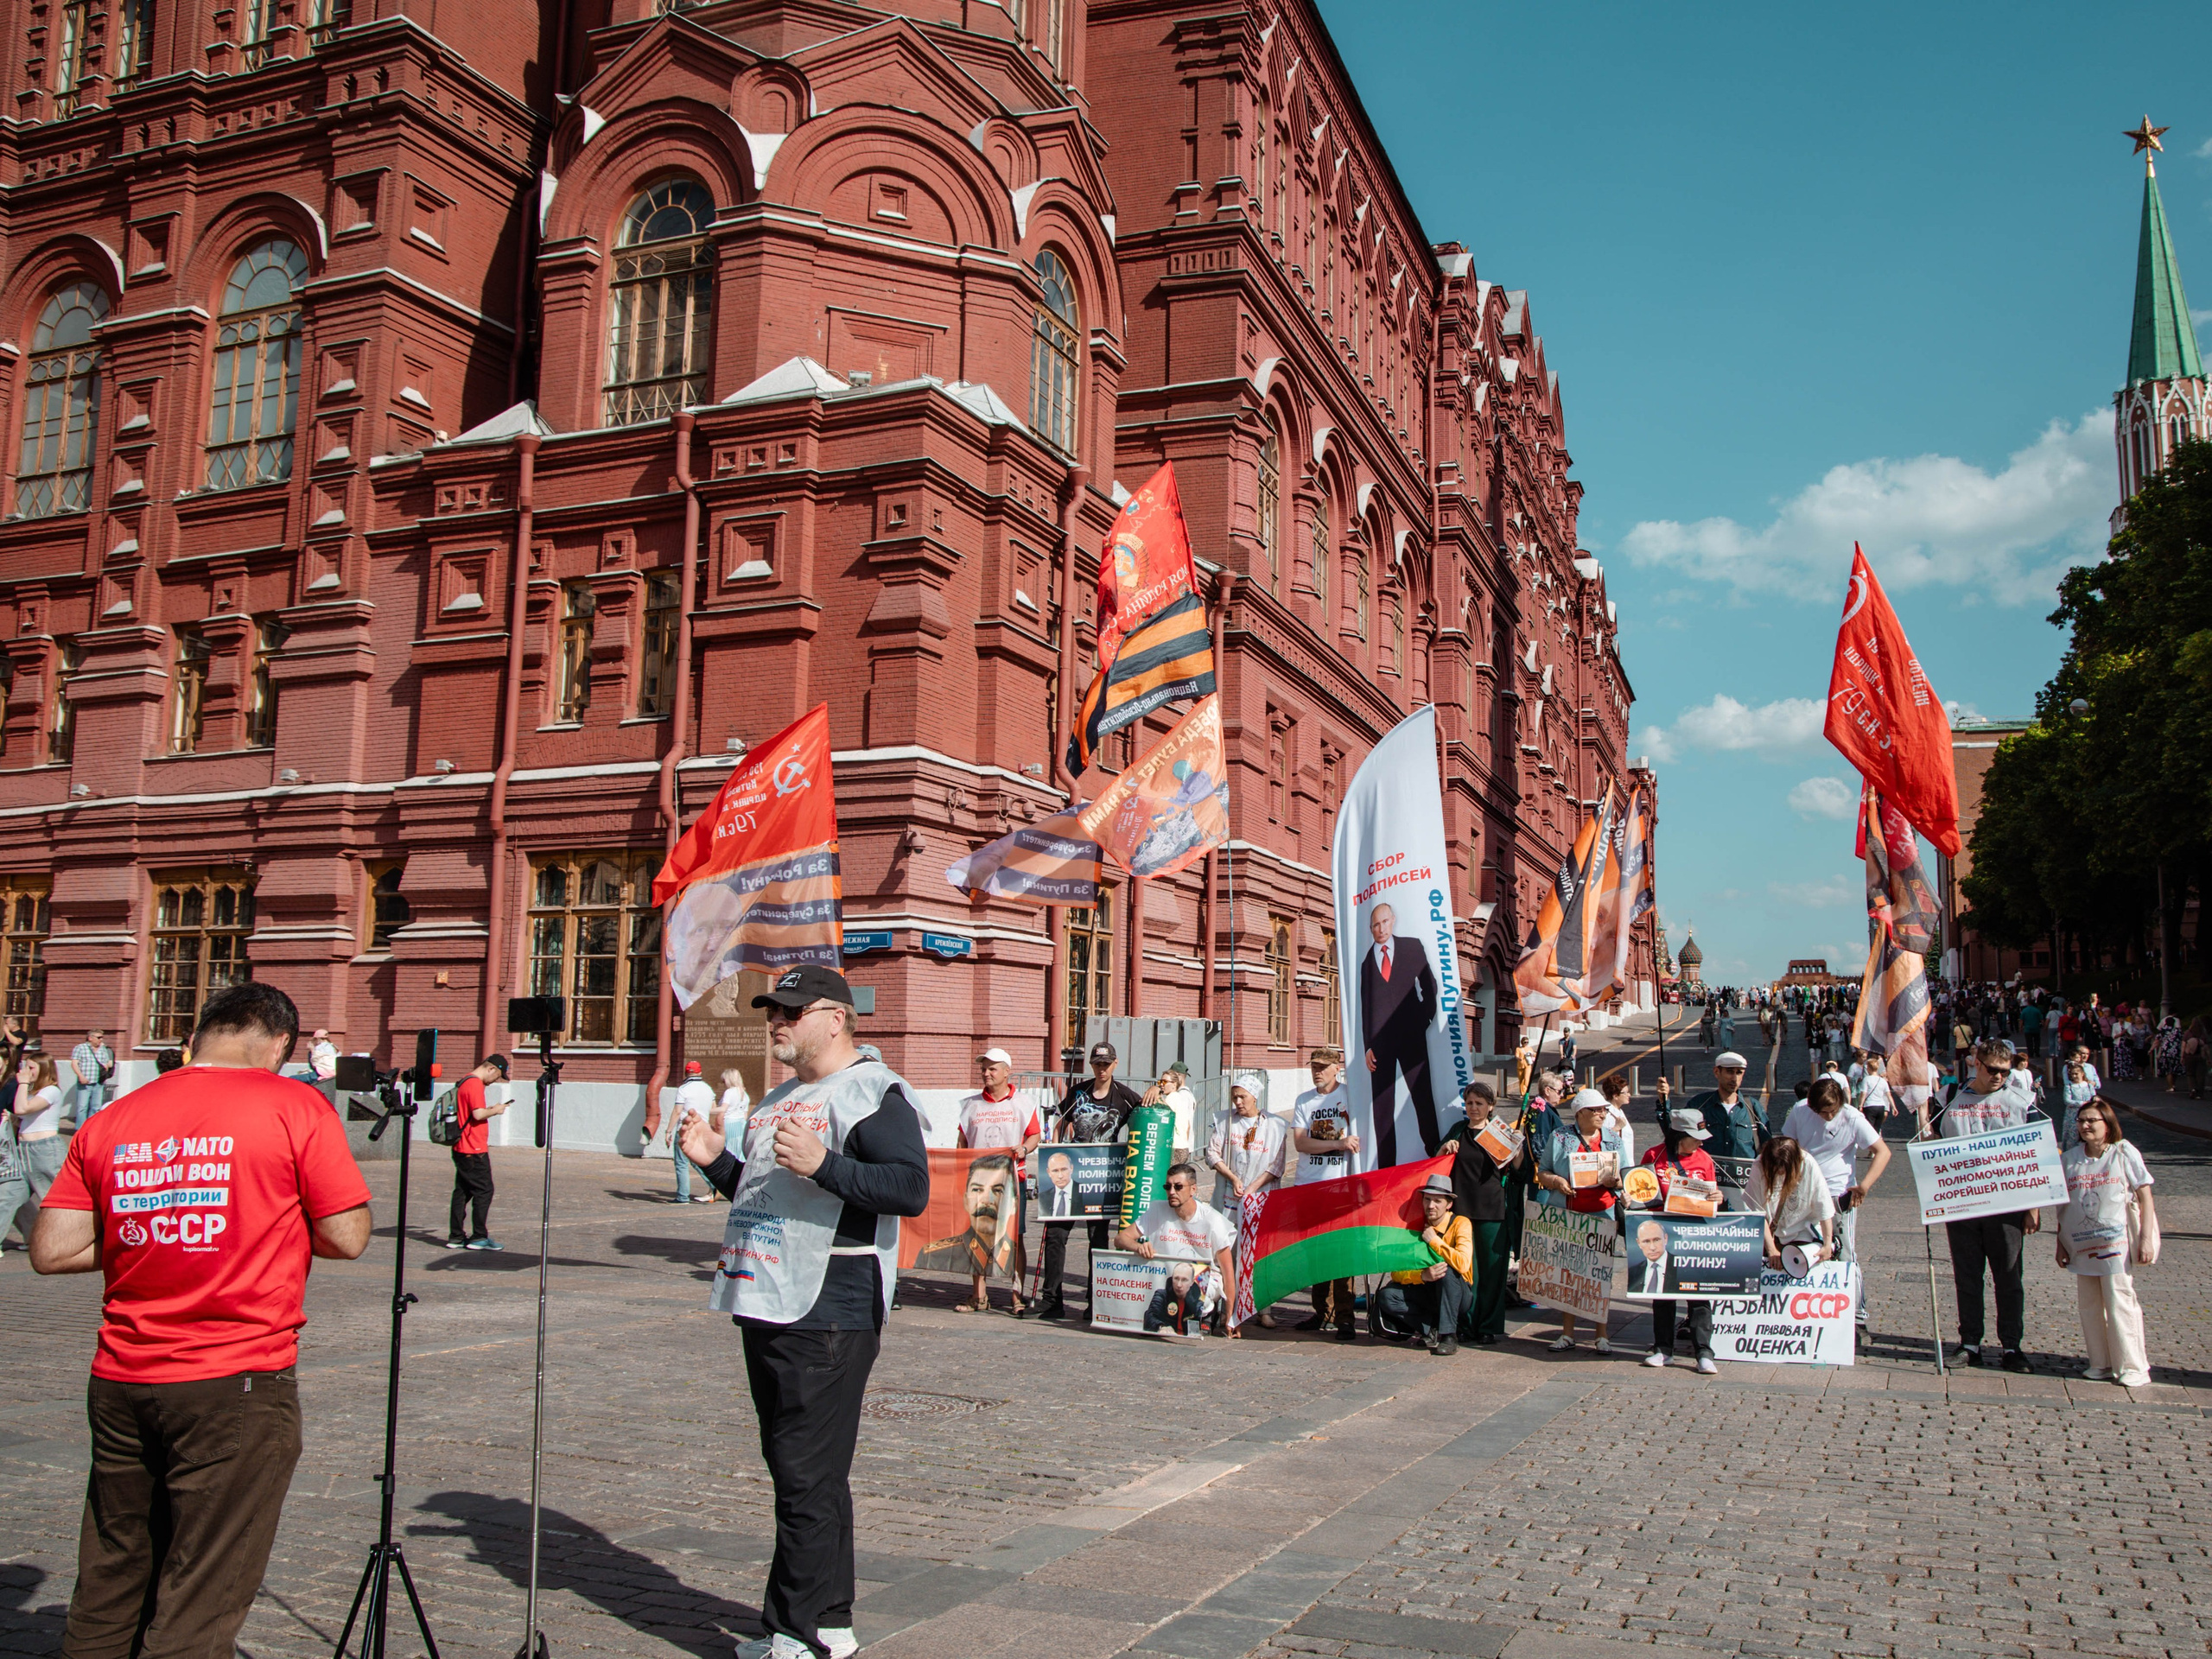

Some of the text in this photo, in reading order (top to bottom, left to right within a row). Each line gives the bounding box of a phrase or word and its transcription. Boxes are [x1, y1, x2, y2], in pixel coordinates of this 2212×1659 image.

[1831, 678, 1866, 715] 79
[1368, 852, 1405, 876] СБОР
[1352, 865, 1431, 906] ПОДПИСЕЙ
[1311, 1107, 1343, 1120] РОССИ
[113, 1136, 234, 1164] USA NATO
[1230, 1133, 1263, 1145] НАРНЫЙ
[1922, 1146, 1961, 1160] ПУТИН
[1968, 1141, 1996, 1151] НАШ
[1999, 1131, 2043, 1147] ЛИДЕР!
[1078, 1157, 1126, 1166] ЧРЕЗВЫЧА
[1138, 1122, 1158, 1214] ВЕРНЕМ ПОЛЕ
[1934, 1149, 2037, 1174] ЗА ЧРЕЗВЫЧАЙНЫЕ
[114, 1163, 231, 1188] ПОШЛИ ВОН
[1119, 1130, 1141, 1229] НА ВАШИ
[1938, 1163, 2039, 1188] ПОЛНОМОЧИЯ ДЛЯ
[2069, 1171, 2110, 1183] НАРОДНЫЙ
[1934, 1176, 2050, 1202] СКОРЕЙШЕЙ ПОБЕДЫ!
[119, 1198, 129, 1208] с
[150, 1214, 226, 1244] СССР
[734, 1220, 783, 1236] НЕВОЗМОЖНО!
[752, 1211, 785, 1225] НАРОДА
[1538, 1204, 1603, 1235] ХВАТИТ
[1169, 1228, 1206, 1240] НАРОДНЫЙ
[1525, 1218, 1585, 1245] ПОДЧИНЯТЬСЯ
[1673, 1225, 1759, 1237] ЧРЕЗВЫЧАЙНЫЕ
[1524, 1232, 1599, 1265] ПОРА ЗАМЕНИТЬ
[1675, 1241, 1751, 1252] ПОЛНОМОЧИЯ
[1096, 1262, 1166, 1275] КУРСОМ ПУТИНА
[1674, 1256, 1726, 1268] ПУТИНУ!
[1109, 1278, 1153, 1289] СПАСЕНИЕ
[1521, 1258, 1602, 1297] КУРС ПУТИНА
[1761, 1274, 1815, 1288] ОБЯКОВА
[1096, 1289, 1145, 1302] ОТЕЧЕСТВА!
[1712, 1292, 1850, 1320] РАЗВАЛУ СССР
[1712, 1324, 1813, 1338] НУЖНА ПРАВОВАЯ
[1735, 1338, 1807, 1358] ОЦЕНКА
